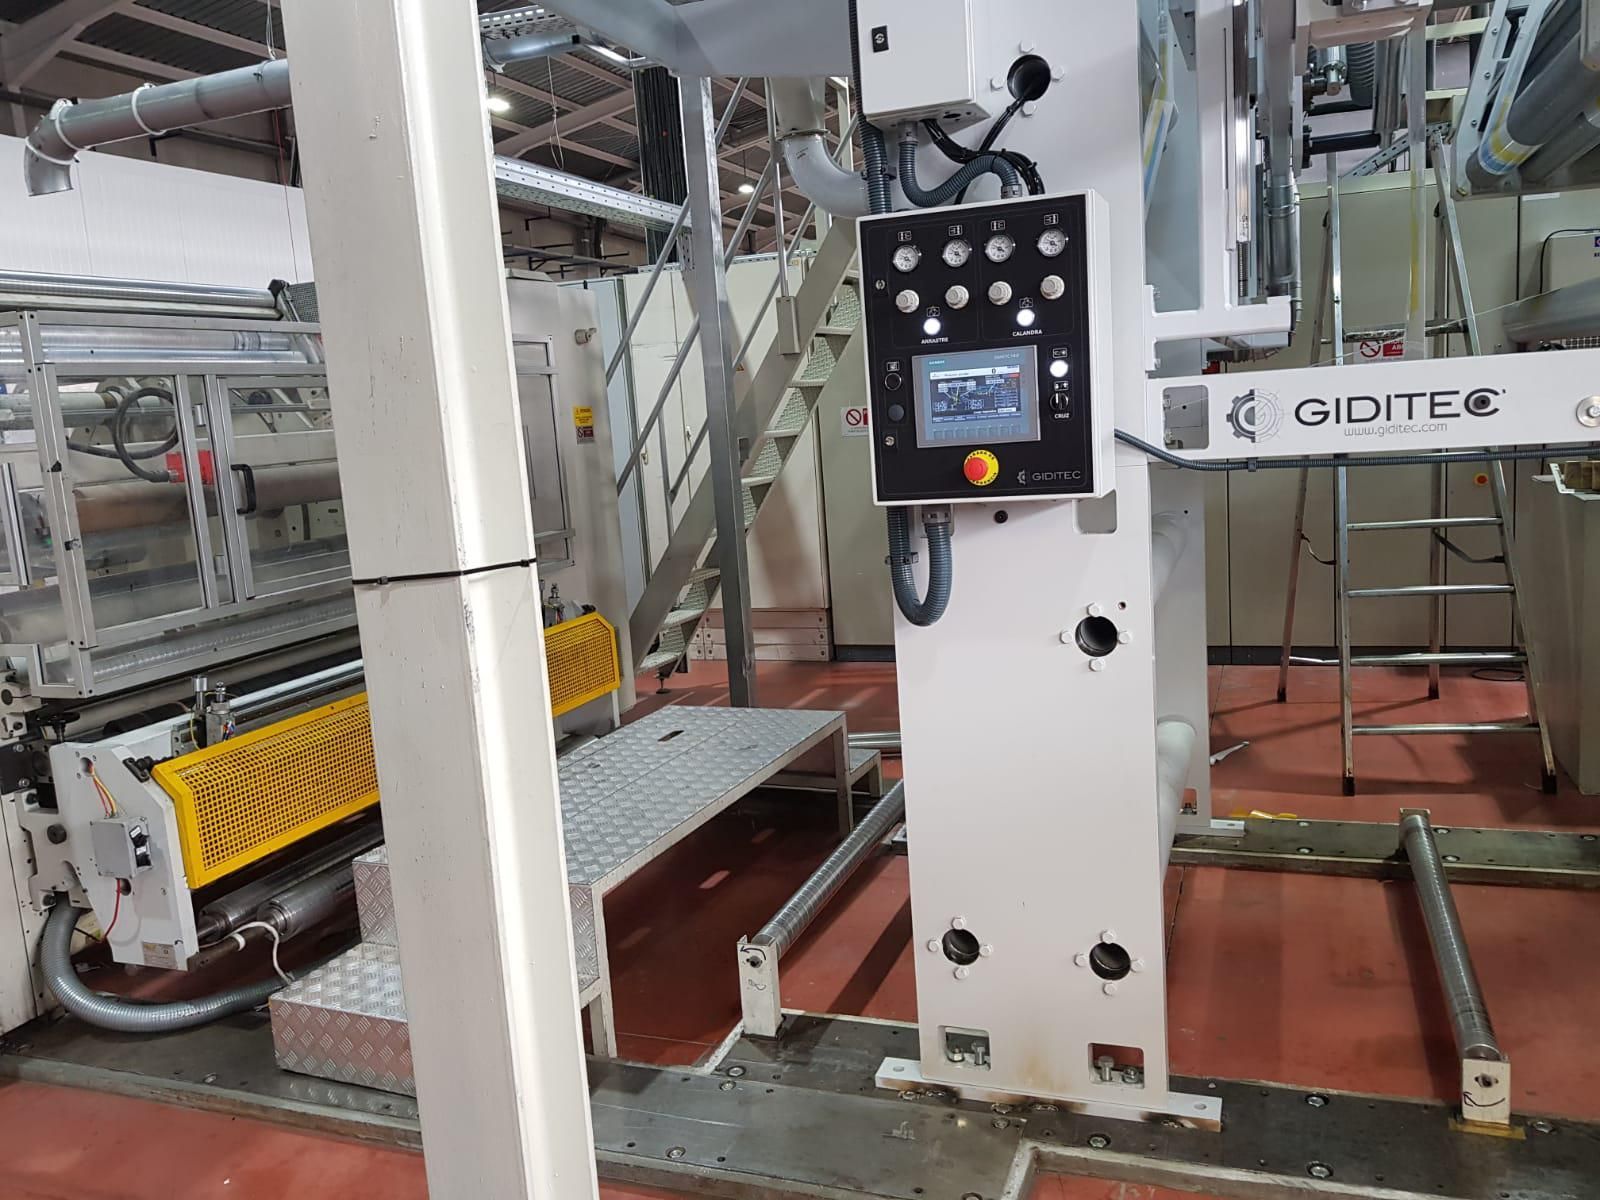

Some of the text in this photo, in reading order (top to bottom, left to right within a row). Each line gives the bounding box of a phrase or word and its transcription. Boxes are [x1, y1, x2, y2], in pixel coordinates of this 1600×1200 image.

[1012, 329, 1043, 337] CALANDRA
[1294, 387, 1500, 427] GIDITEC
[1343, 421, 1448, 437] www.giditec.com
[1032, 471, 1081, 481] GIDITEC
